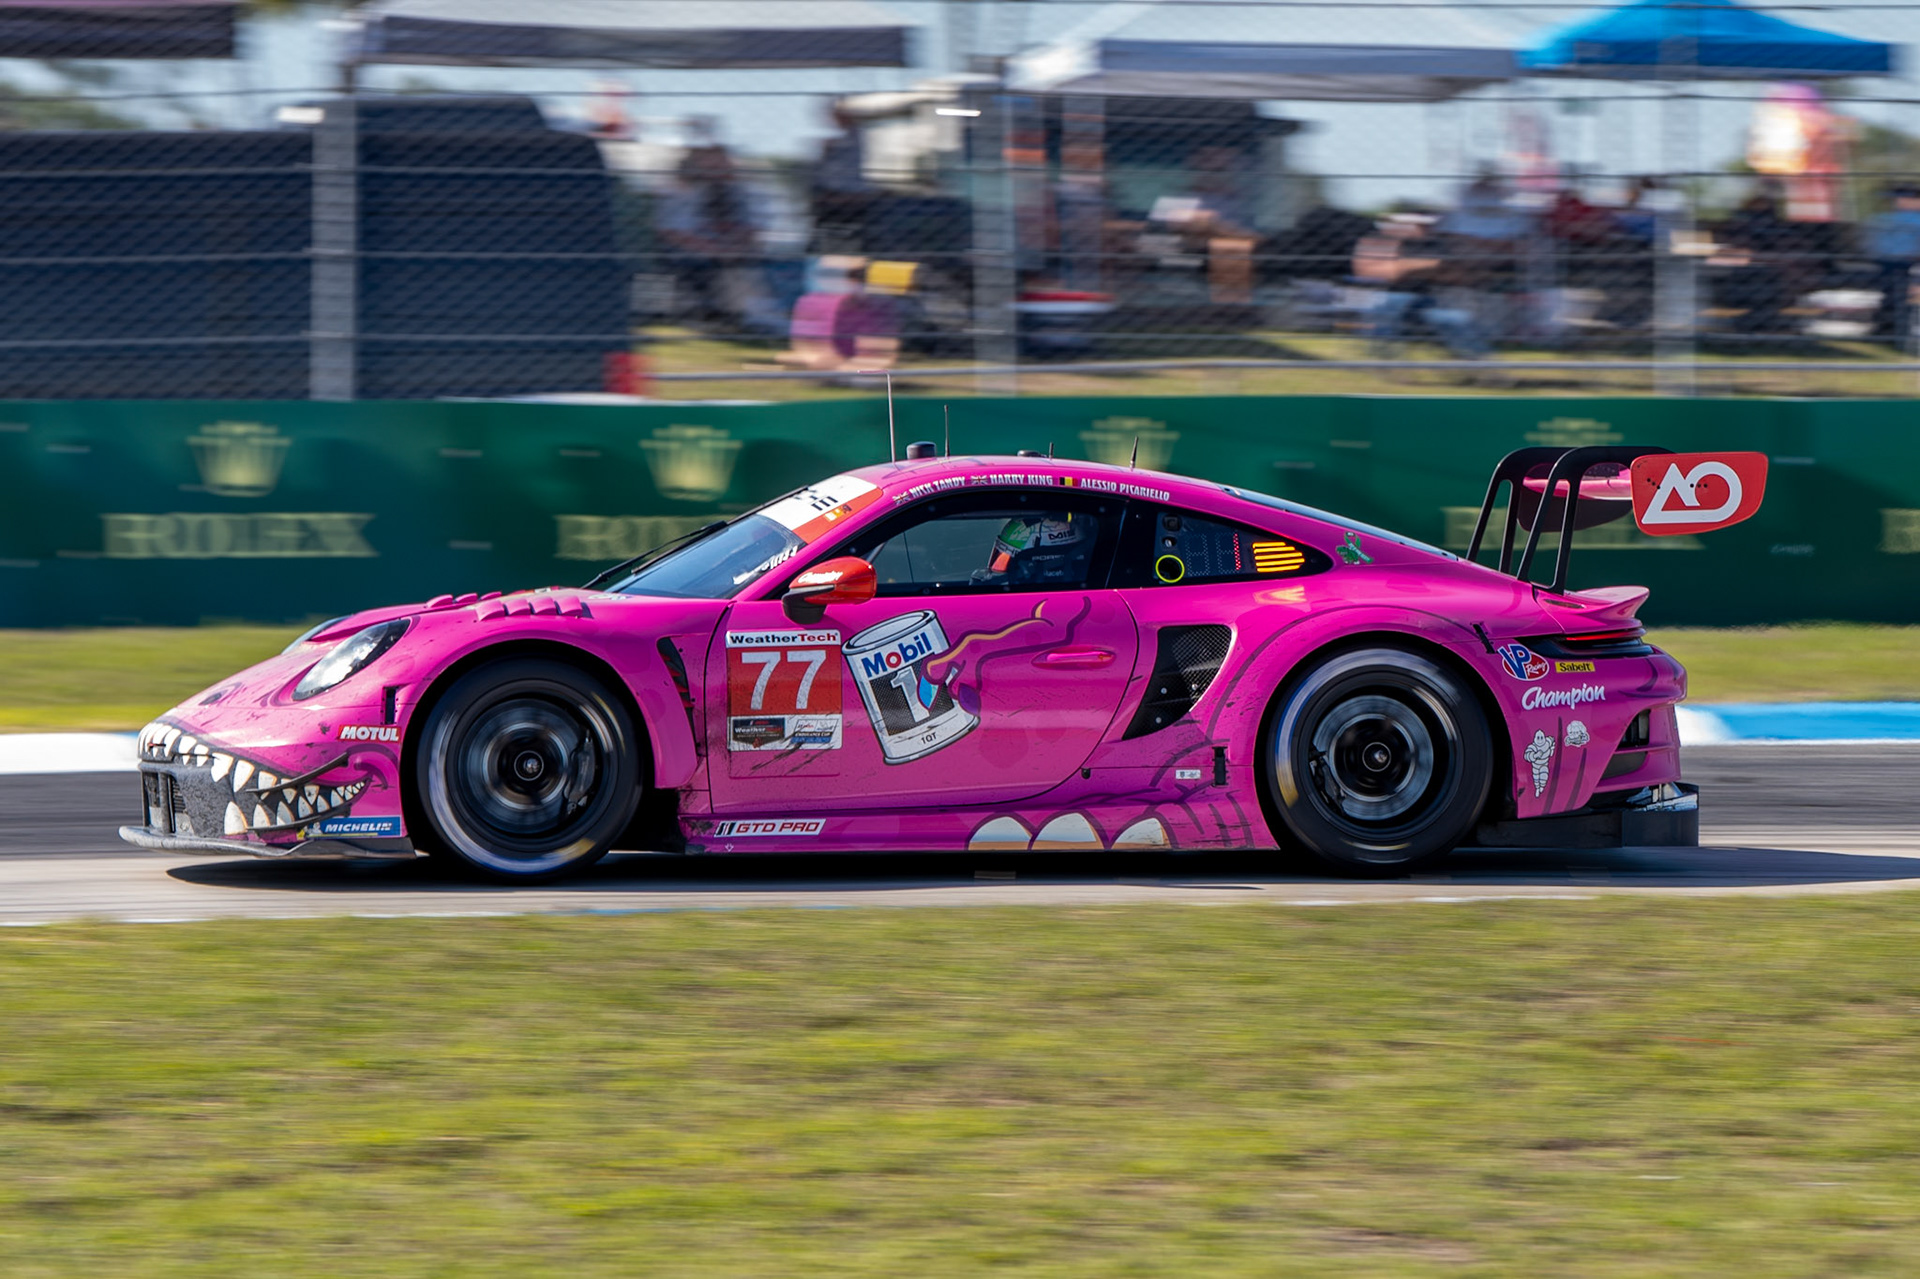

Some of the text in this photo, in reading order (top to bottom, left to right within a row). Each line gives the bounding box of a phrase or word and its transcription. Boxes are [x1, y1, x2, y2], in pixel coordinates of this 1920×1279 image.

[909, 476, 966, 498] NICK TANDY
[989, 473, 1054, 486] HARRY KING
[1081, 478, 1170, 501] ALESSIO PICARIELLO
[731, 632, 837, 644] WeatherTech
[861, 631, 933, 678] Mobil
[1498, 643, 1548, 680] VP Racing
[1559, 662, 1591, 672] Sabelt
[741, 650, 827, 710] 77
[890, 666, 931, 723] 1
[1522, 683, 1606, 711] Champion
[340, 726, 399, 741] MOTUL
[325, 822, 392, 833] MICHELIN
[736, 821, 821, 833] GTD PRO
